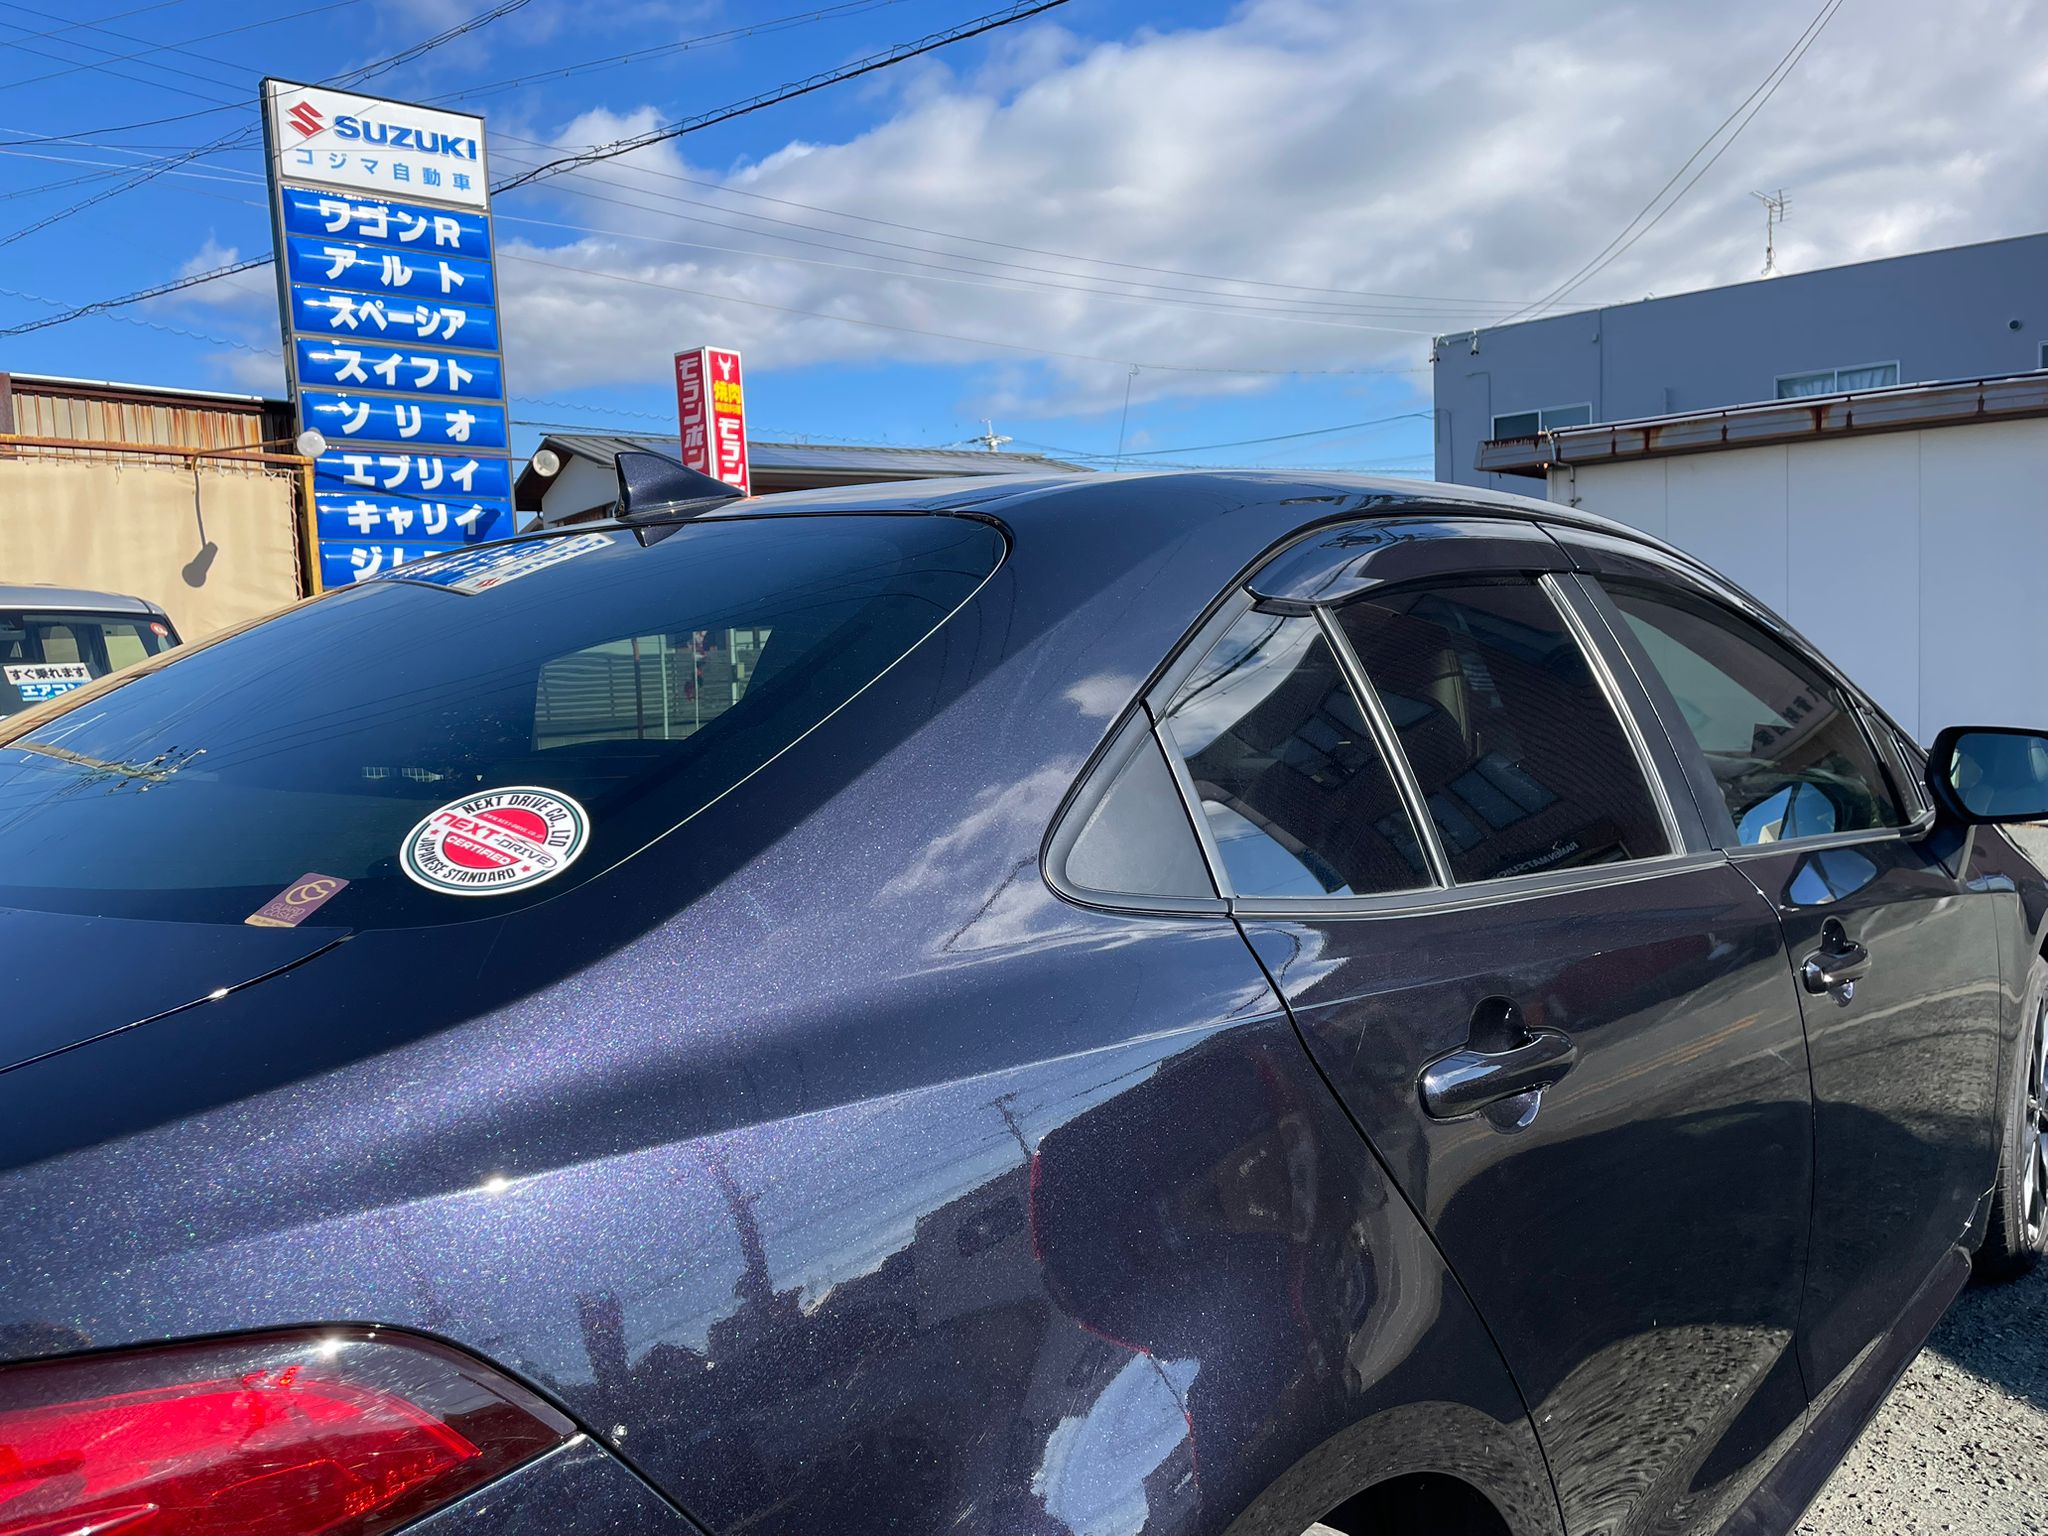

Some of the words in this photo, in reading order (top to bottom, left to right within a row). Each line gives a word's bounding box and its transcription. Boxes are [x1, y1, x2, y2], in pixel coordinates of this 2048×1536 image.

[335, 115, 477, 161] SUZUKI
[295, 147, 472, 191] コジマ自動車
[319, 198, 462, 248] ワゴンR
[323, 246, 465, 293] アルト
[328, 295, 467, 340] スペーシア
[333, 349, 473, 391] スイフト
[713, 380, 742, 404] 焼肉
[338, 401, 476, 442] ソリオ
[679, 357, 705, 471] モランボン
[342, 455, 480, 492] エブリイ
[718, 417, 746, 491] モラン
[347, 500, 486, 535] キャリイ
[9, 667, 84, 680] すぐ乗れます
[462, 796, 504, 814] NEXT
[508, 794, 549, 812] DRIVE
[549, 829, 571, 848] LTD
[420, 837, 447, 875] JAPANESE
[443, 867, 516, 883] STANDARD
[446, 835, 513, 866] CERTIFIED
